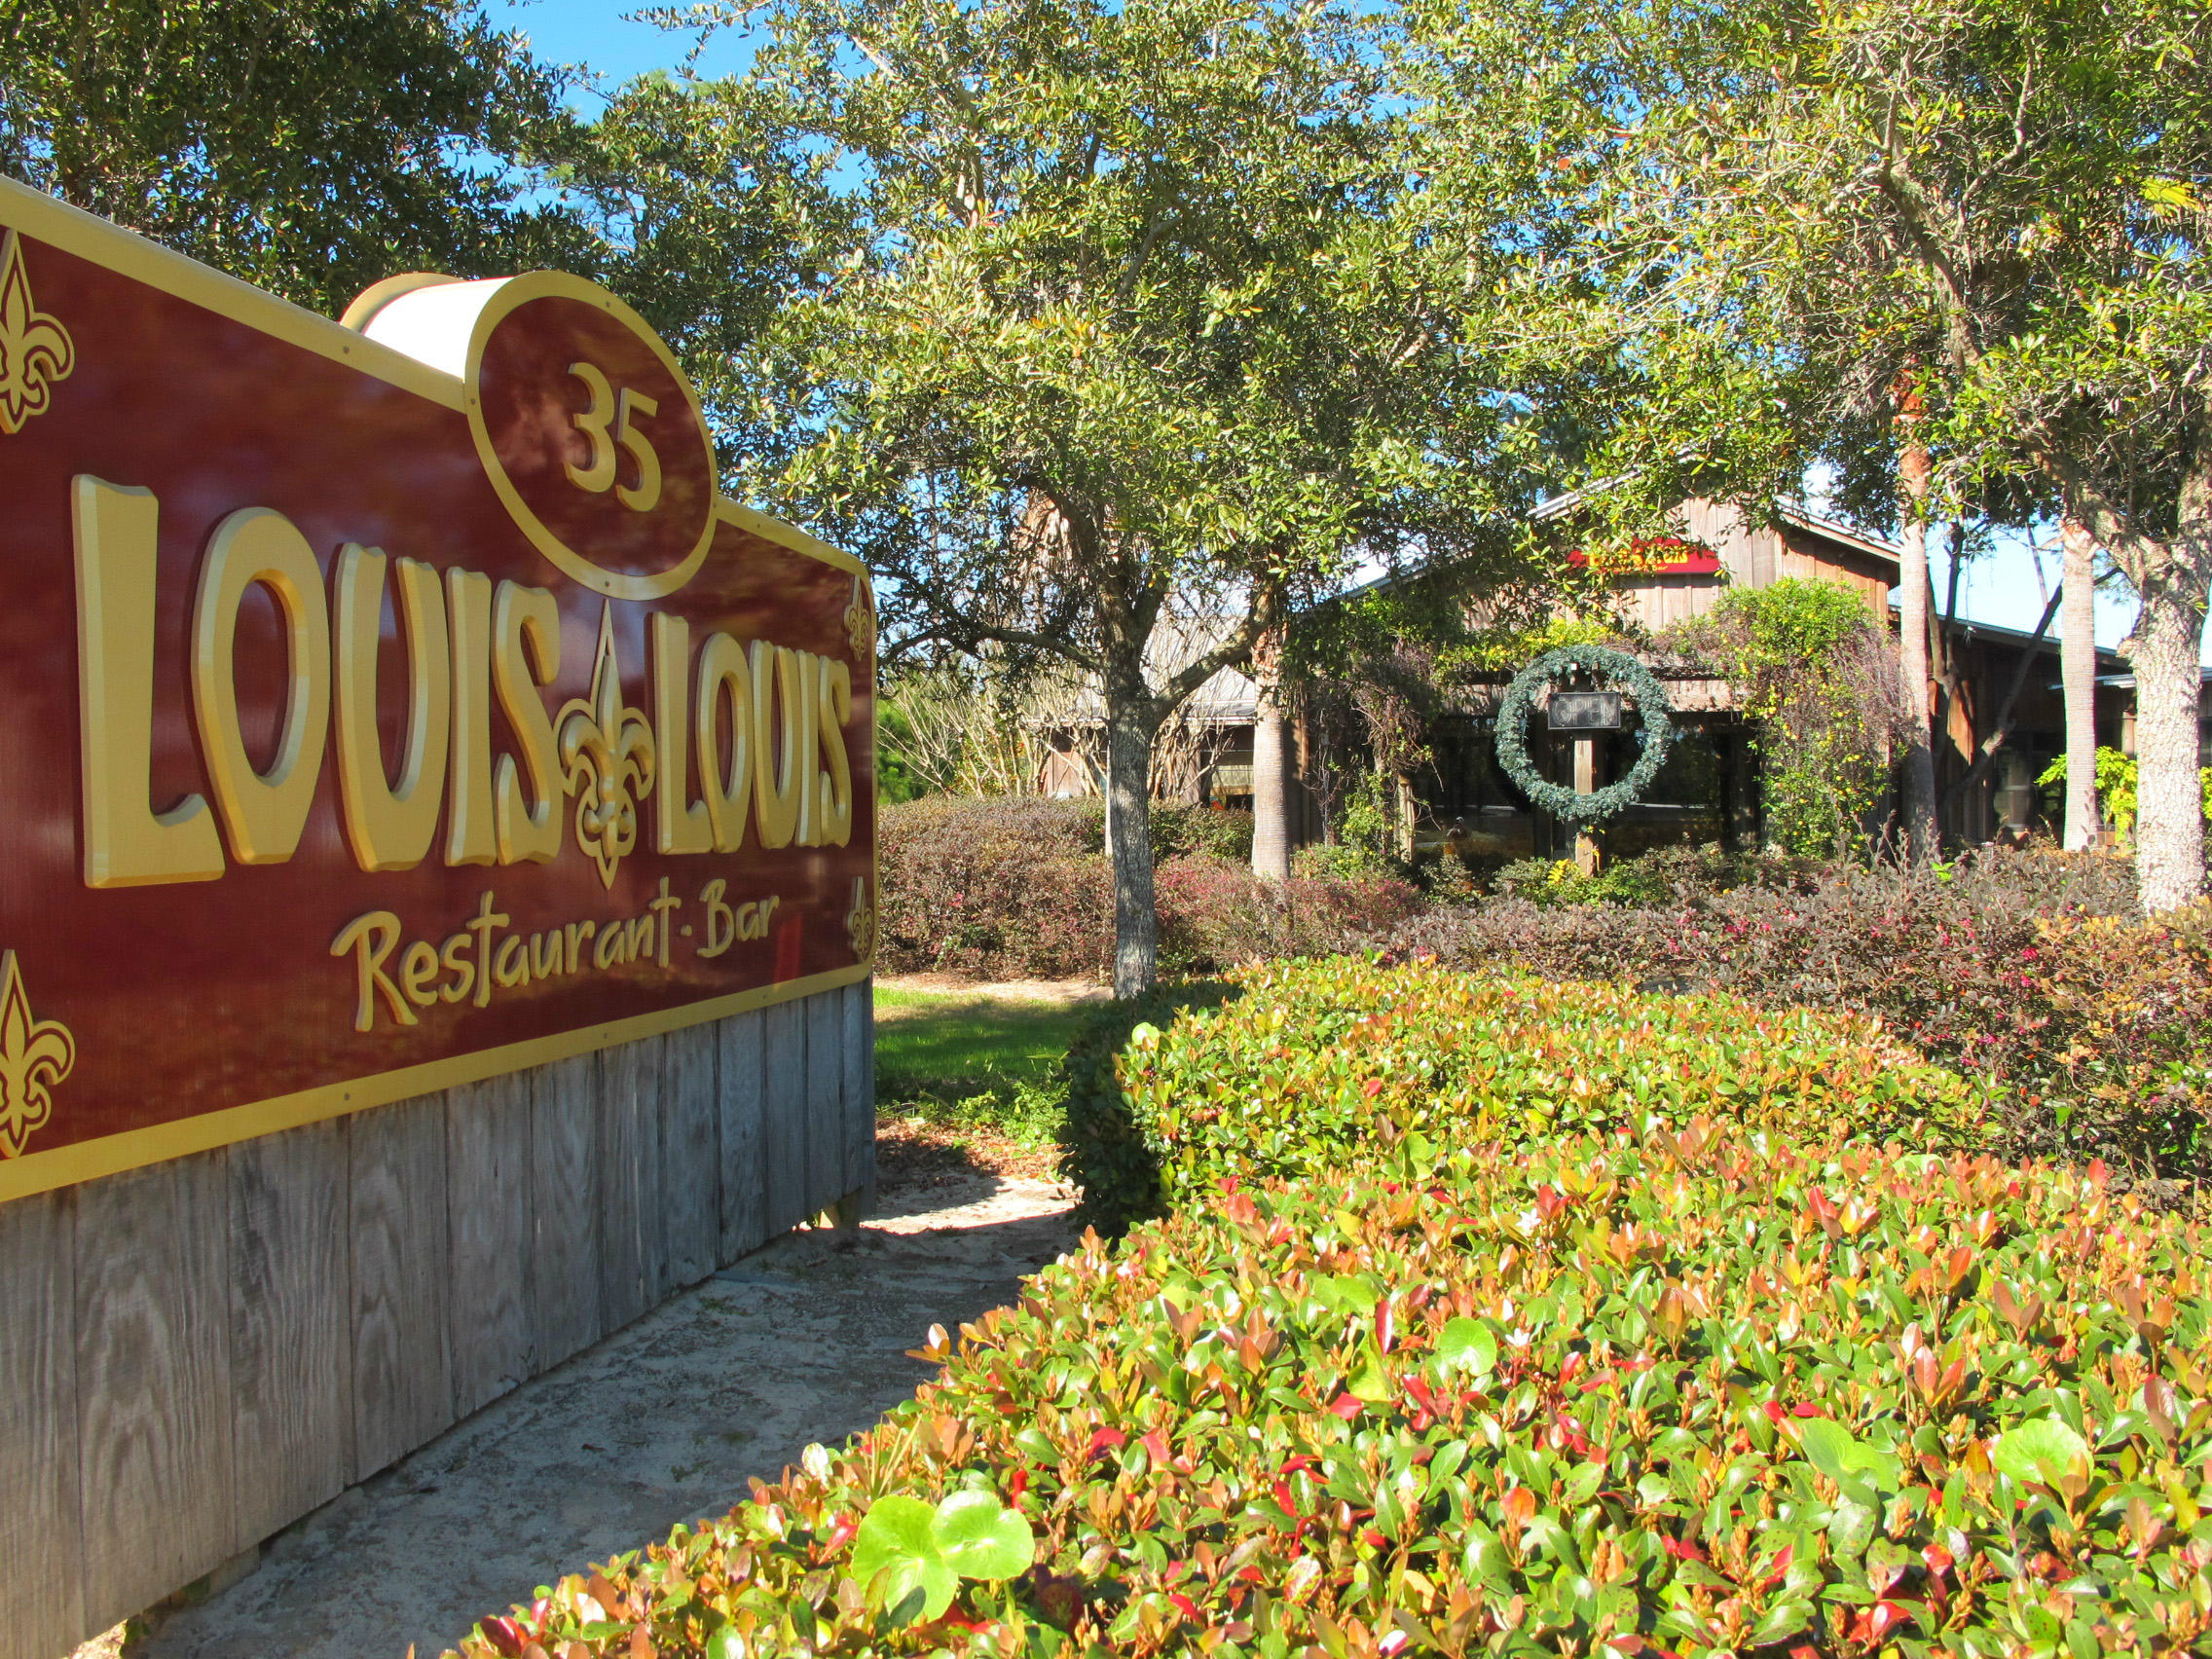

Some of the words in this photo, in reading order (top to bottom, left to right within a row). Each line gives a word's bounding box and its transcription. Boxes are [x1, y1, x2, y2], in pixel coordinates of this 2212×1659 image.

[565, 362, 661, 512] 35
[71, 474, 564, 889] LOUIS
[651, 611, 852, 855] LOUIS
[1553, 696, 1616, 725] OPEN
[330, 877, 681, 1032] Restaurant
[697, 879, 779, 958] Bar
